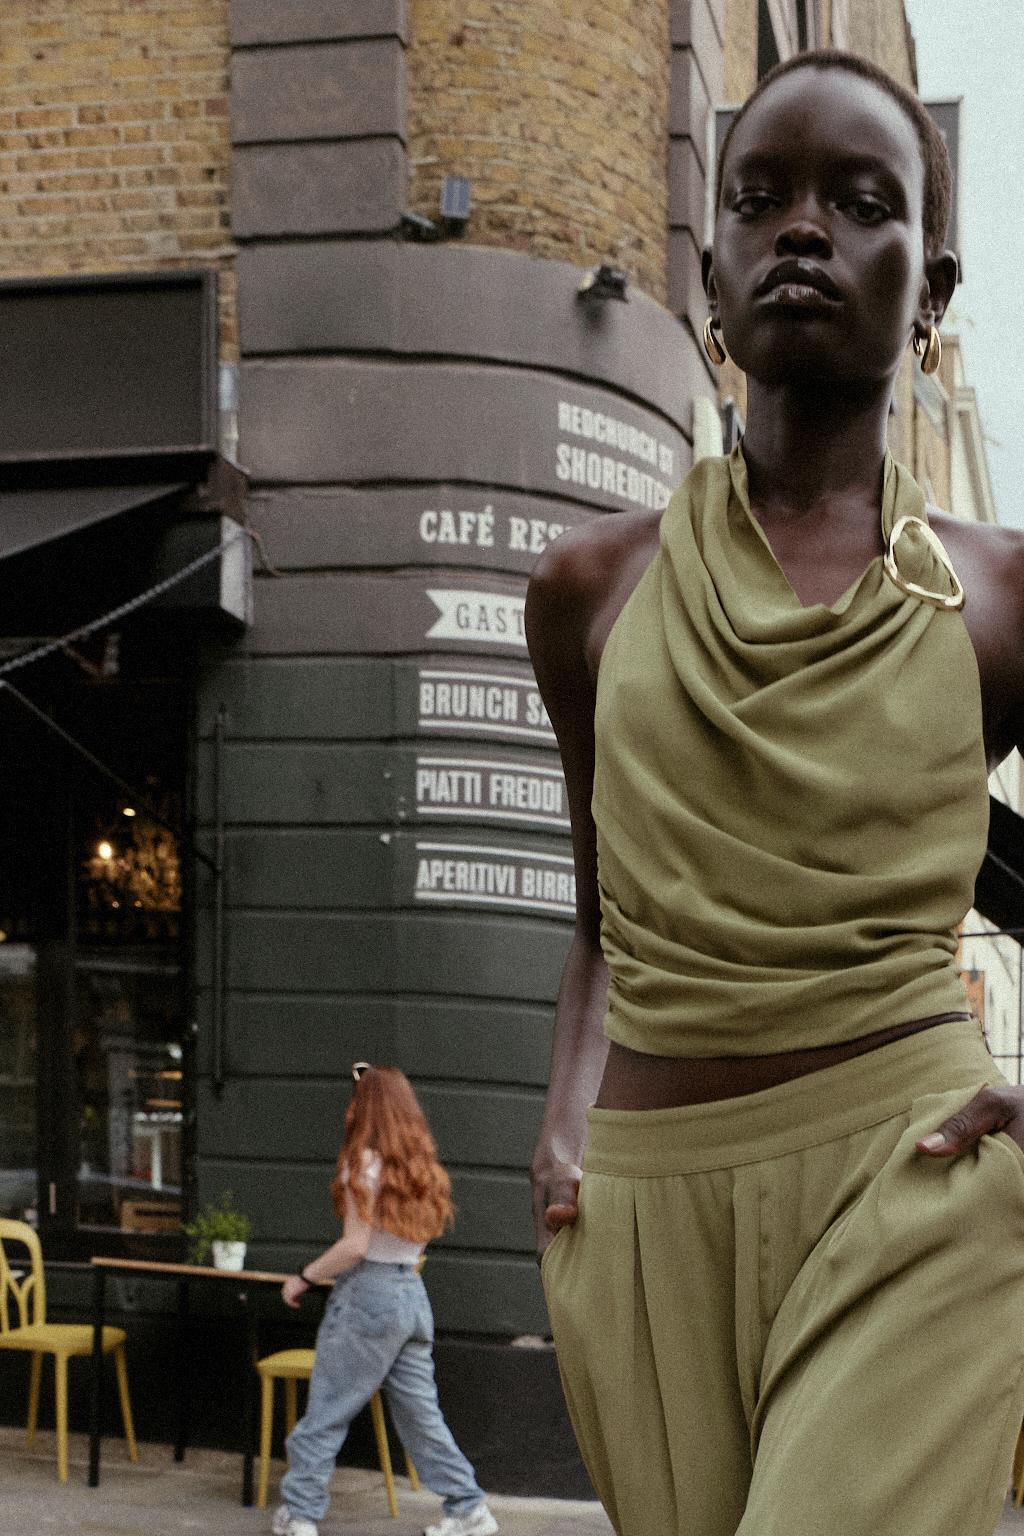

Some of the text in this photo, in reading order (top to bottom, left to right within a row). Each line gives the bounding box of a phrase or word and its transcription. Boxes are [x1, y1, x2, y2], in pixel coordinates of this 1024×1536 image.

[556, 442, 673, 511] SHOREDITC
[419, 504, 573, 554] CAFÉ RE
[419, 682, 519, 722] BRUNCH
[416, 769, 563, 813] PIATTI FREDDI
[415, 859, 517, 896] APERITIVI
